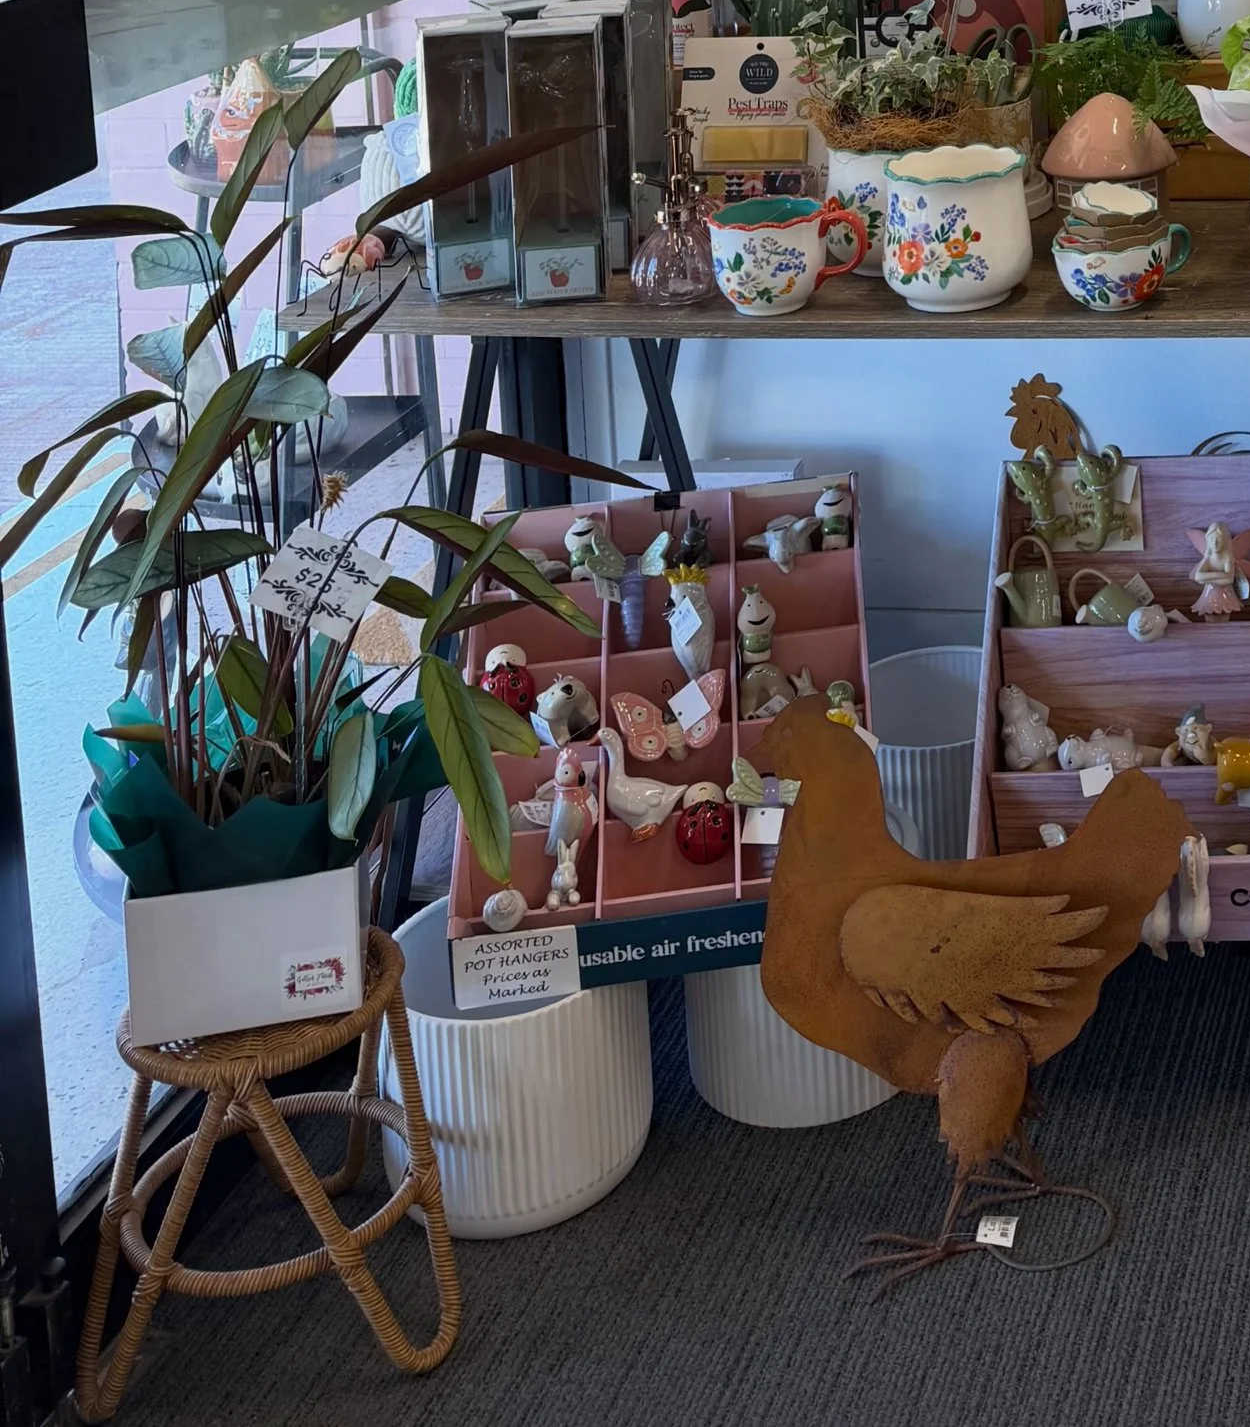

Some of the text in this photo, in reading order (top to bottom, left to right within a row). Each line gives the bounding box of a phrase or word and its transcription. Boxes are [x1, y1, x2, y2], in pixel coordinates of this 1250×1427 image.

[745, 68, 774, 77] WILD
[728, 97, 788, 112] Pest Traps
[475, 935, 553, 956] ASSORTED
[579, 931, 766, 968] usable air freshen
[464, 948, 569, 973] POT HANGERS
[483, 968, 551, 987] Prices as
[488, 982, 550, 1000] Marked
